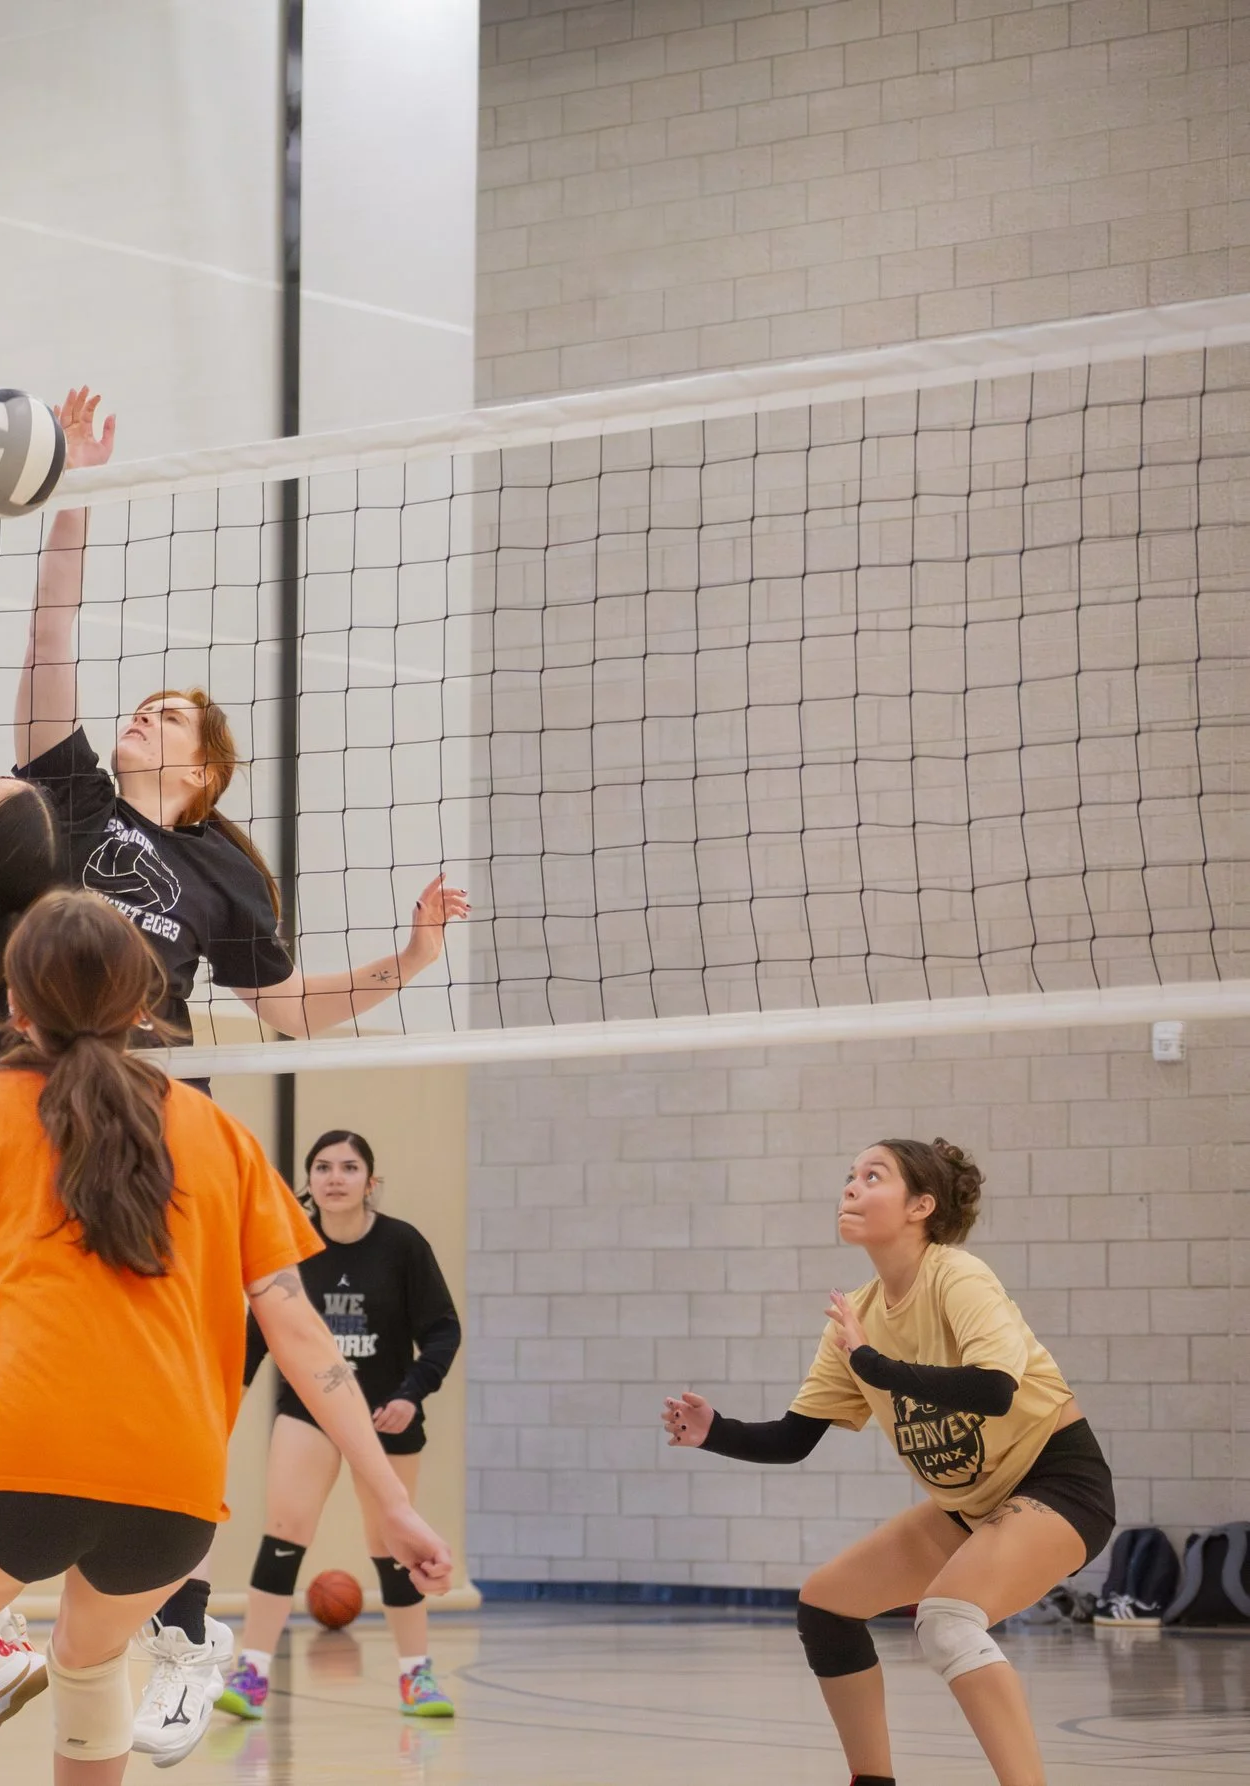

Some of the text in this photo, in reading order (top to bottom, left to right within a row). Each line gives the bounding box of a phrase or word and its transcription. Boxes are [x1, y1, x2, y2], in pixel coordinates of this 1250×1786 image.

[141, 911, 181, 942] 2023
[323, 1293, 365, 1315] WE
[897, 1411, 980, 1451] DENVER
[924, 1447, 967, 1467] LYNX
